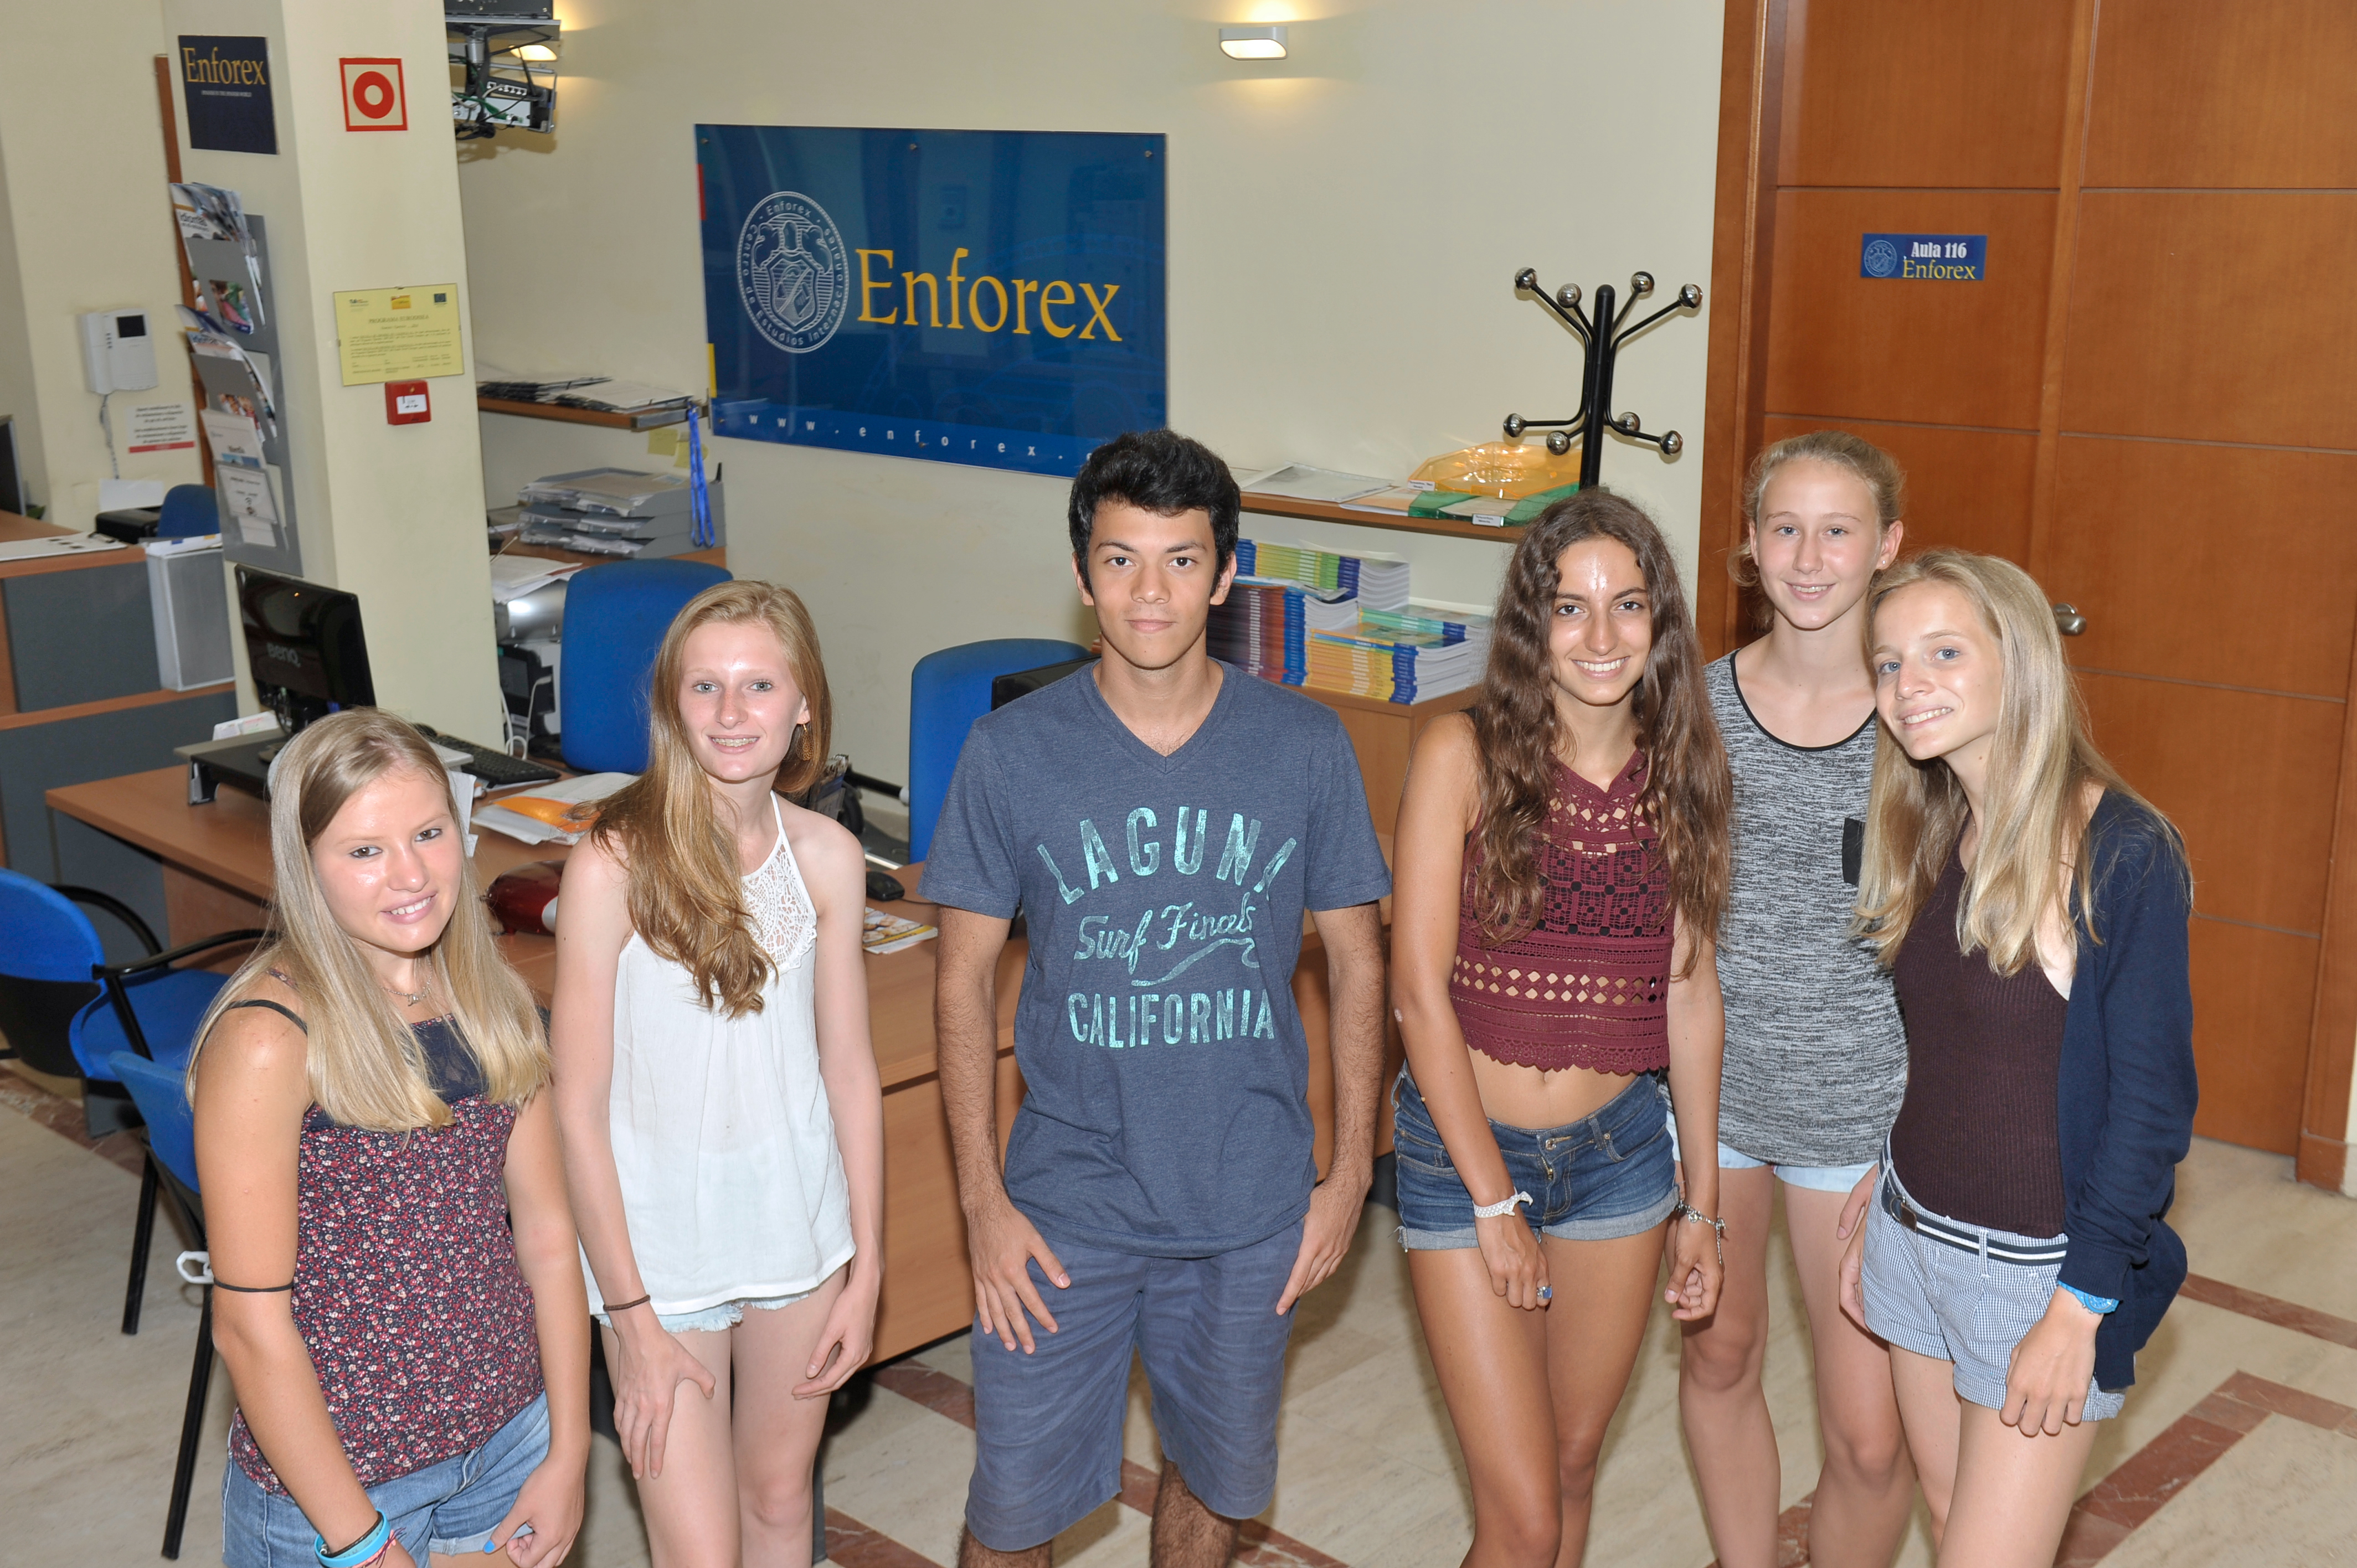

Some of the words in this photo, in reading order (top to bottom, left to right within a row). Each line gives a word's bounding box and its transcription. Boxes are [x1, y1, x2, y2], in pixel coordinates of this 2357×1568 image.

[182, 47, 266, 85] Enforex
[766, 201, 812, 218] Enforex
[1902, 260, 1976, 280] Enforex
[1911, 241, 1941, 258] Aula
[1944, 243, 1967, 259] 116
[742, 224, 758, 276] Centro
[755, 310, 804, 345] Estudios
[807, 228, 844, 342] Internacionales
[856, 247, 1123, 342] Enforex
[1037, 806, 1297, 905] LAGUNA
[1074, 910, 1153, 975] Surf
[1156, 892, 1256, 951] Finals
[1068, 988, 1275, 1049] CALIFORNIA
